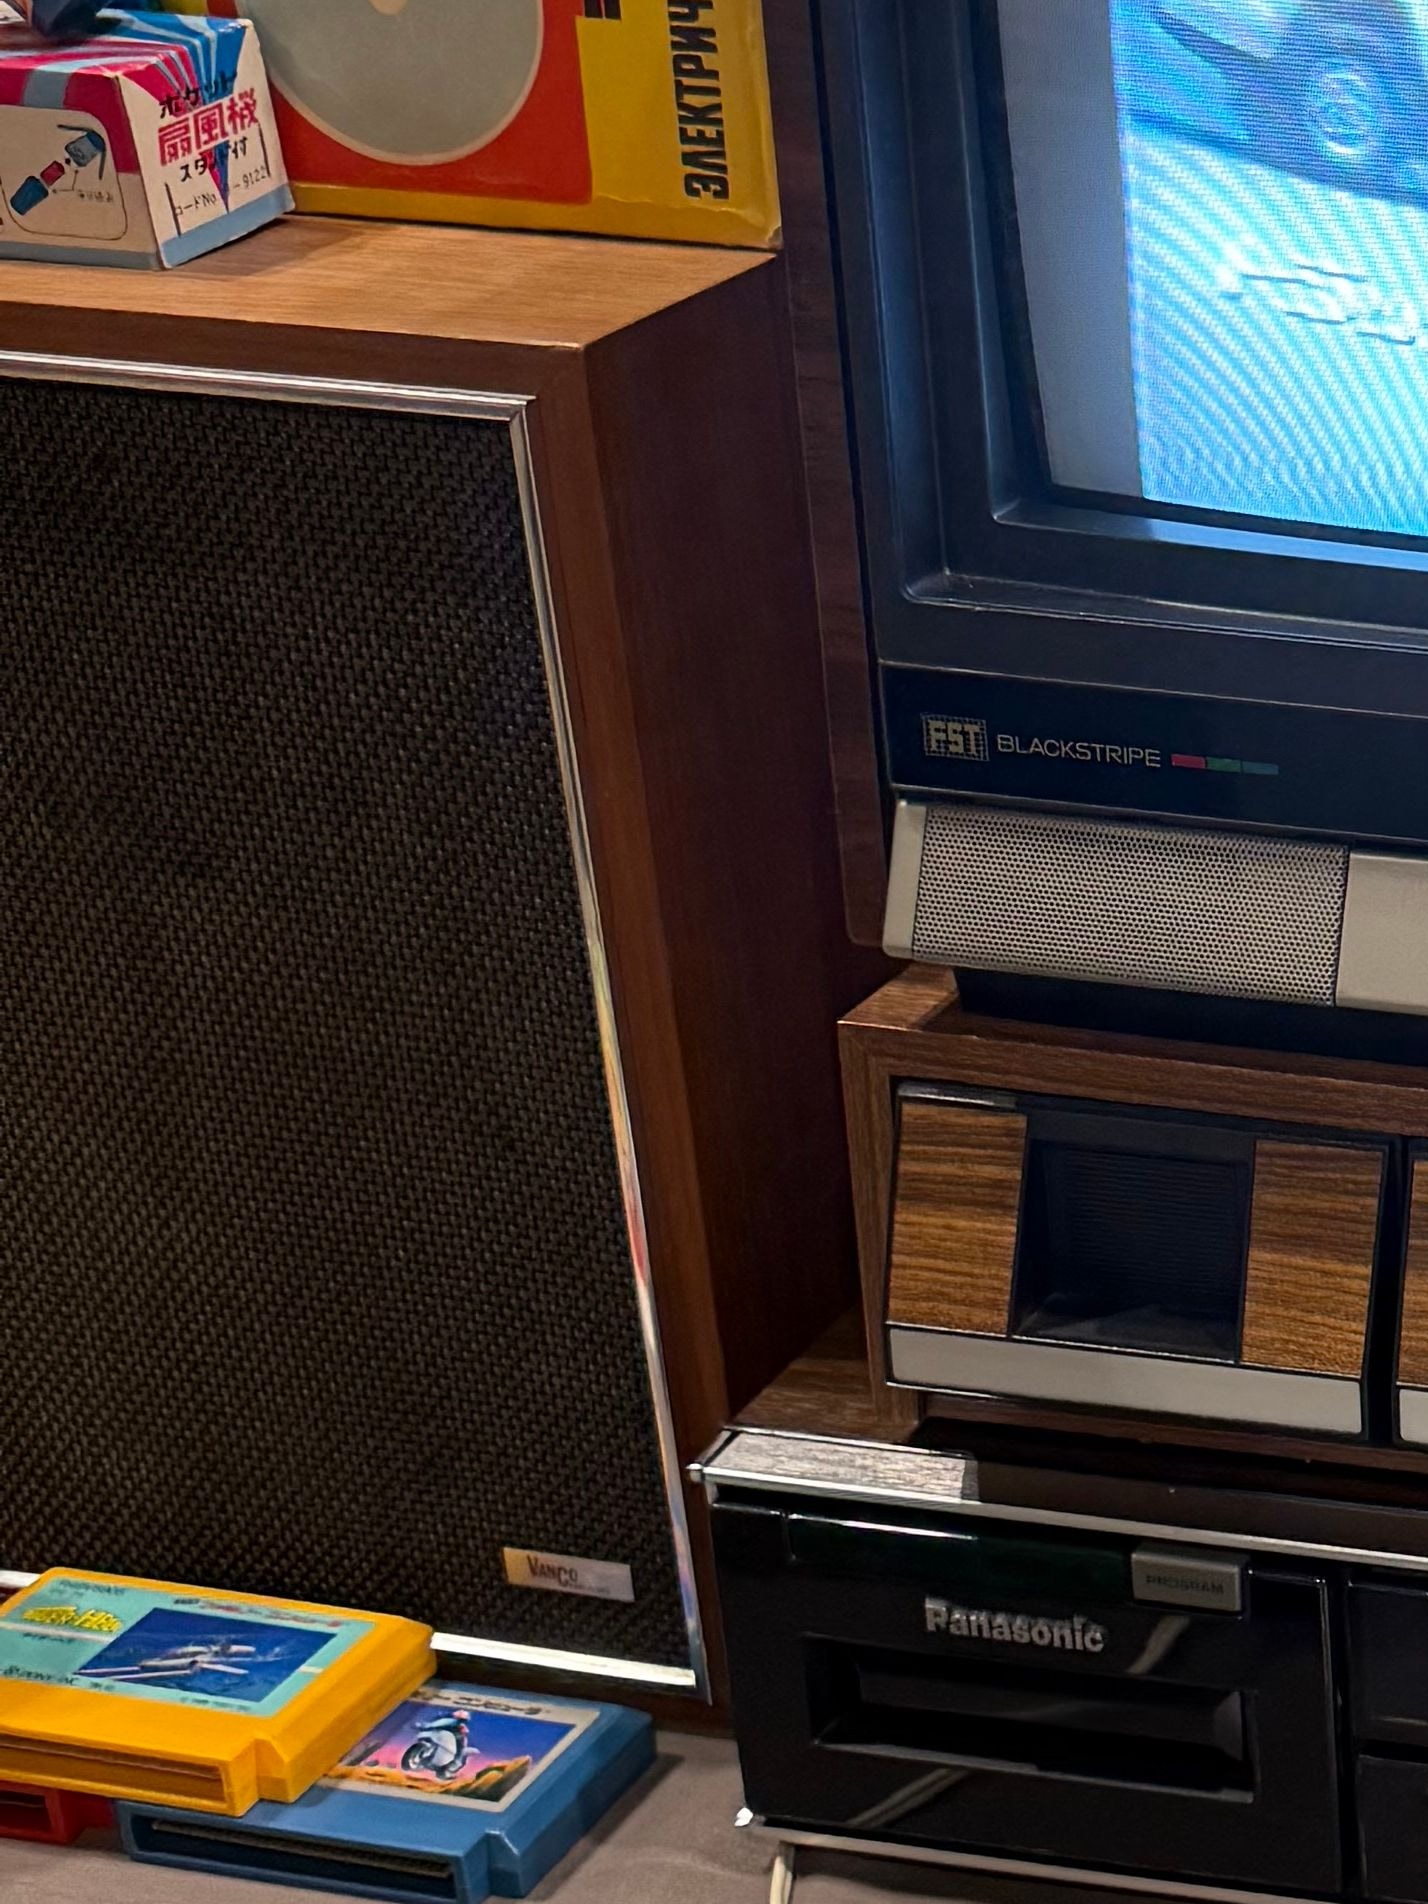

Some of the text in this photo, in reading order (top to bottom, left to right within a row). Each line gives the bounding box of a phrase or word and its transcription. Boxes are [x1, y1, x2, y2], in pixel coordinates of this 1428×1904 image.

[926, 719, 1162, 768] FST BLACKSTRIPE
[925, 1595, 1105, 1653] Panasonic
